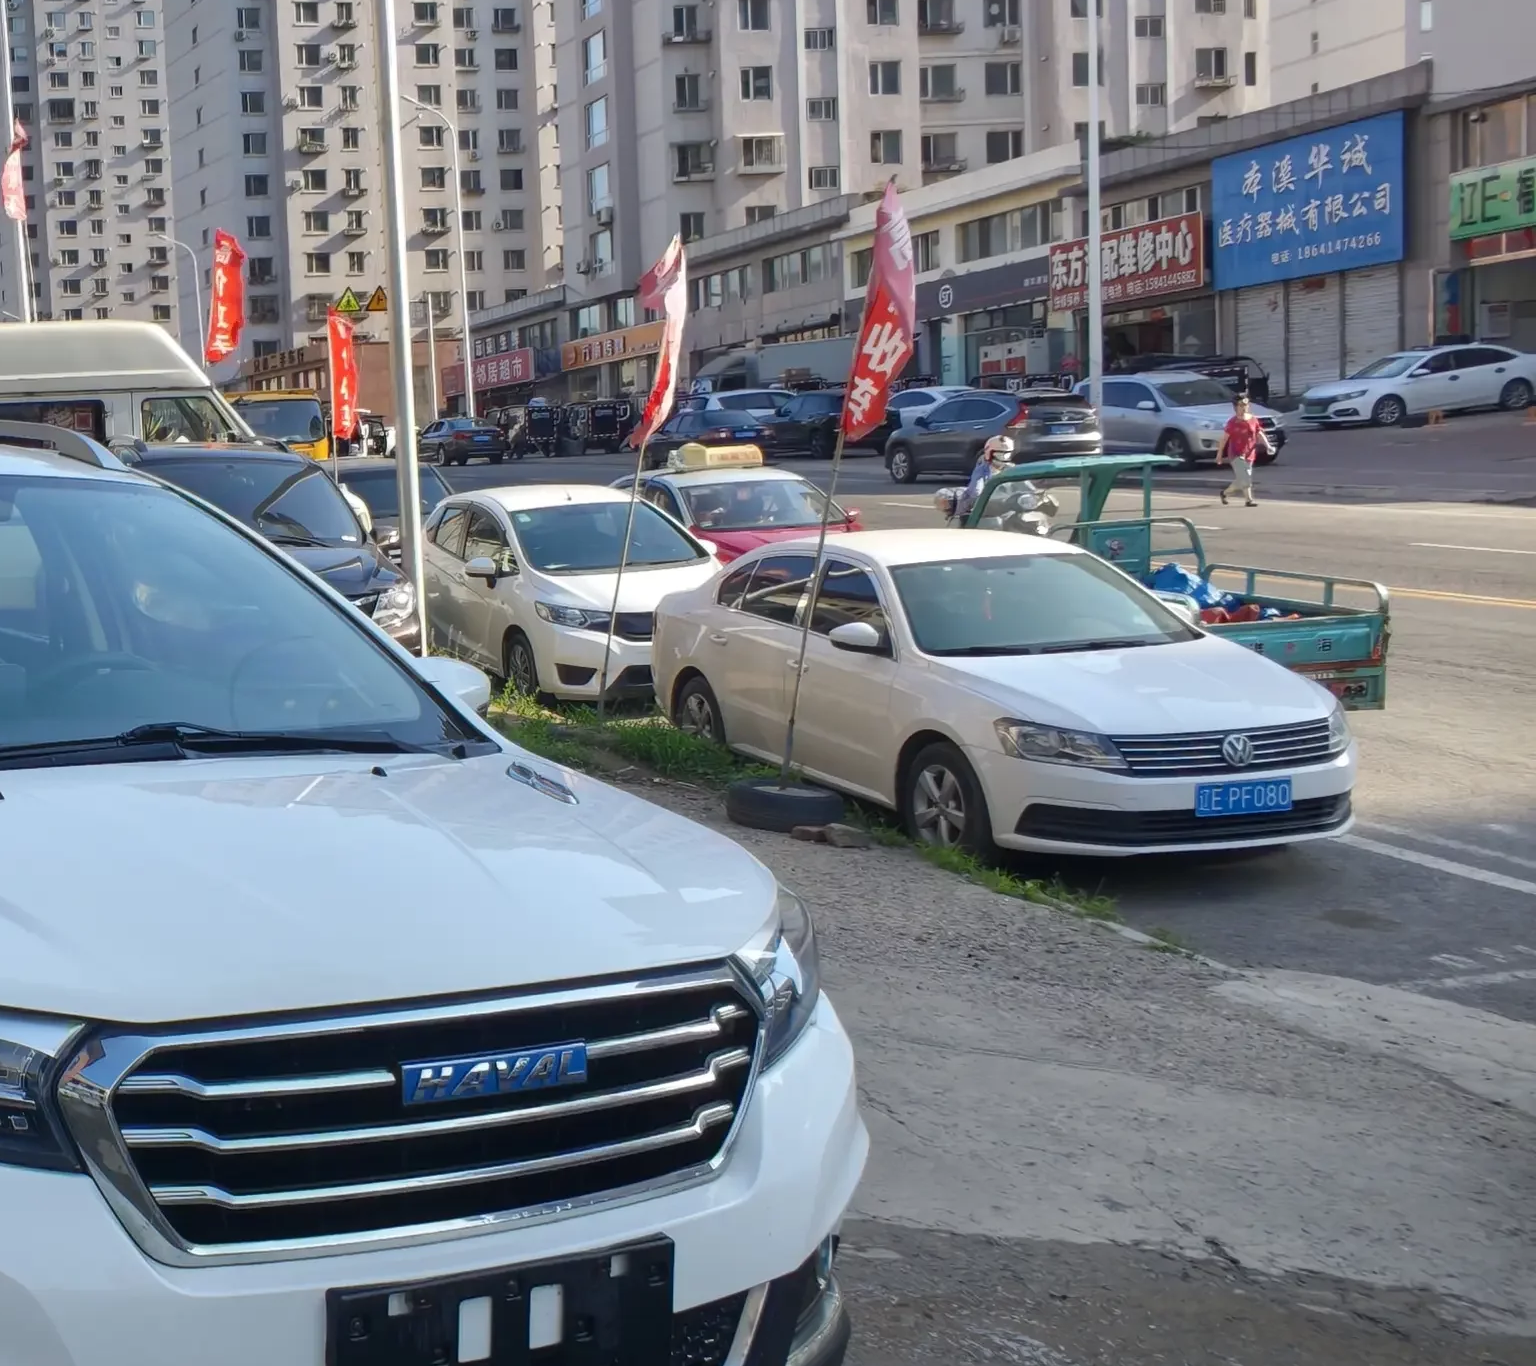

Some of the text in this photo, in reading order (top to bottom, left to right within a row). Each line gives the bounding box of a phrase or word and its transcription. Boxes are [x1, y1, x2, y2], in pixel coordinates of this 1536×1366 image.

[1242, 134, 1373, 203] 本溪华诚
[1218, 182, 1392, 248] 医疗器械有限公司
[471, 356, 523, 385] 邻居超市
[413, 1050, 586, 1101] HAVAL
